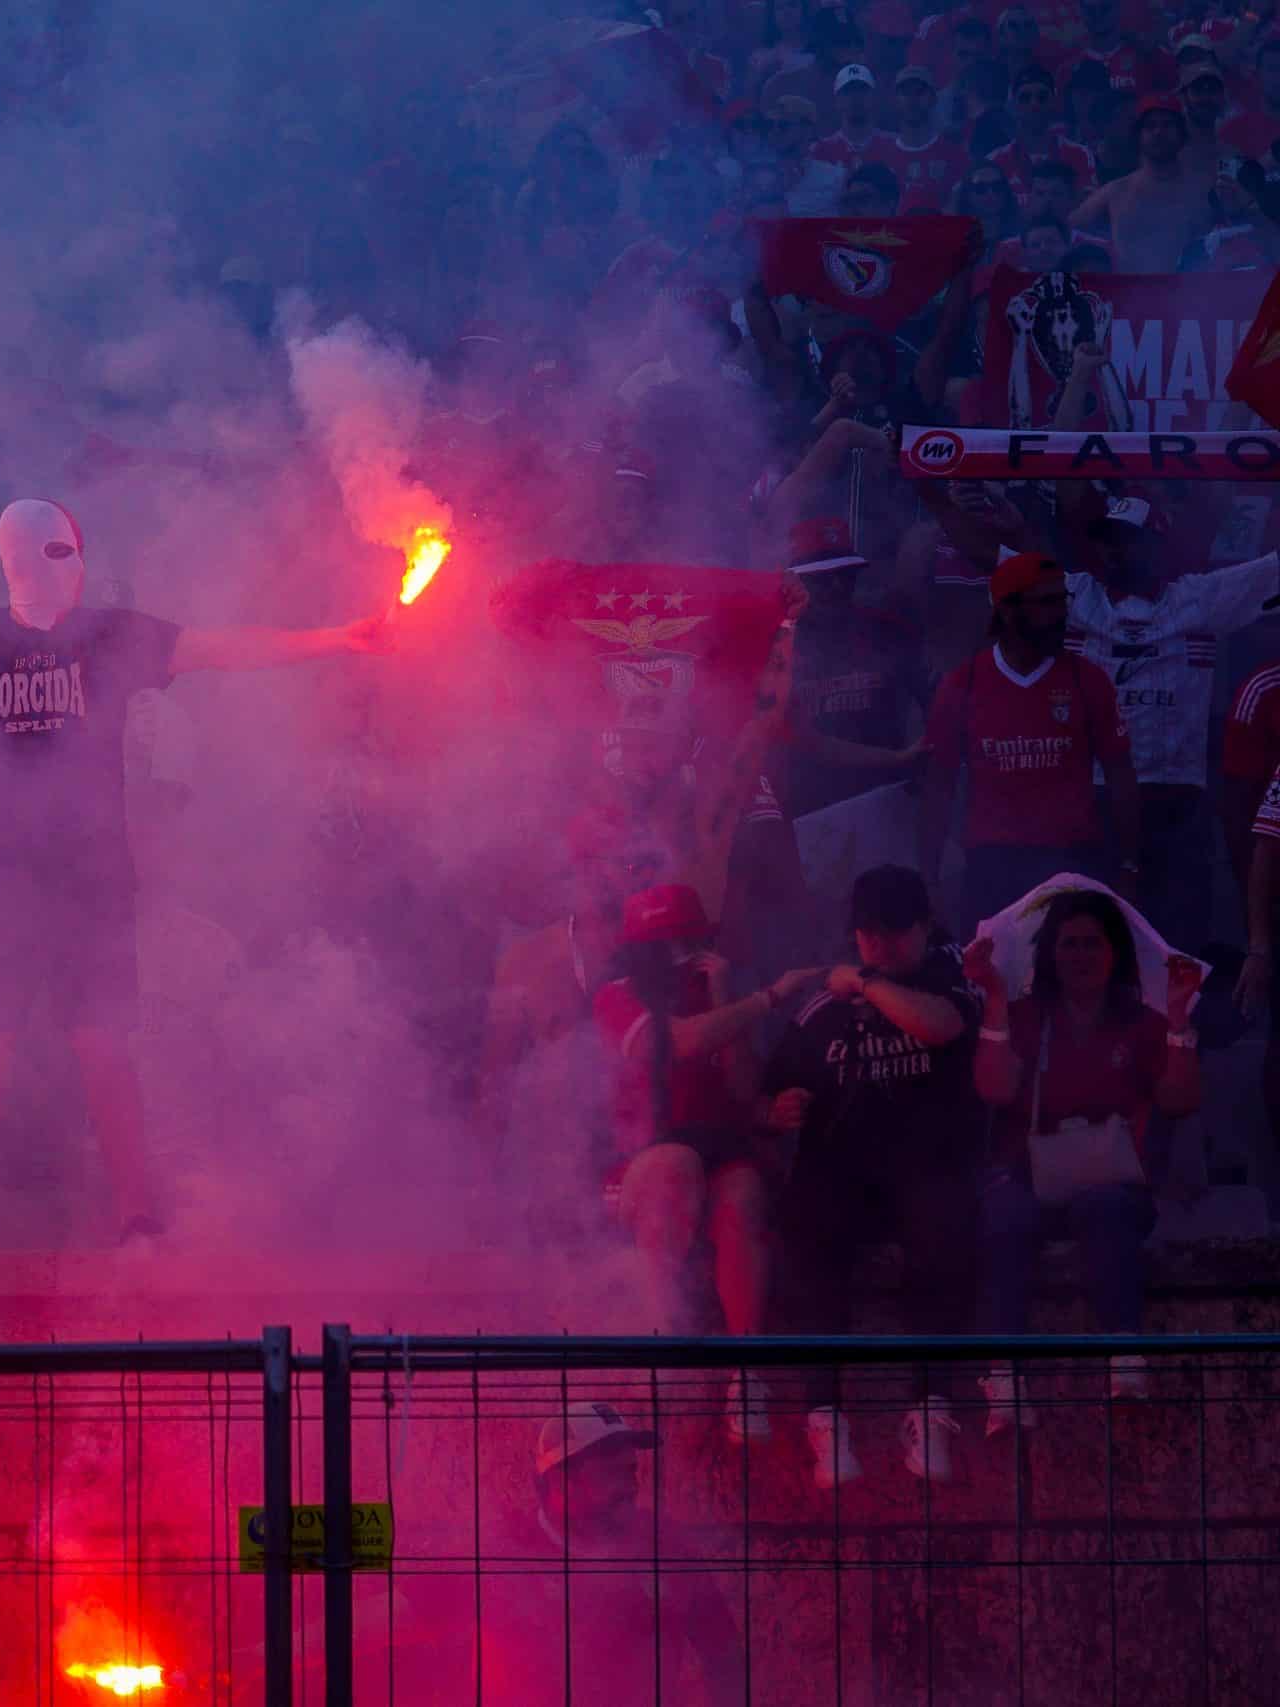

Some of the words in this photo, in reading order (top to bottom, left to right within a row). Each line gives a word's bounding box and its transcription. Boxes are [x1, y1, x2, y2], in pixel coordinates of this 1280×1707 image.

[1009, 433, 1280, 471] FARO
[5, 718, 64, 733] SPLIT
[982, 735, 1072, 753] Emirates
